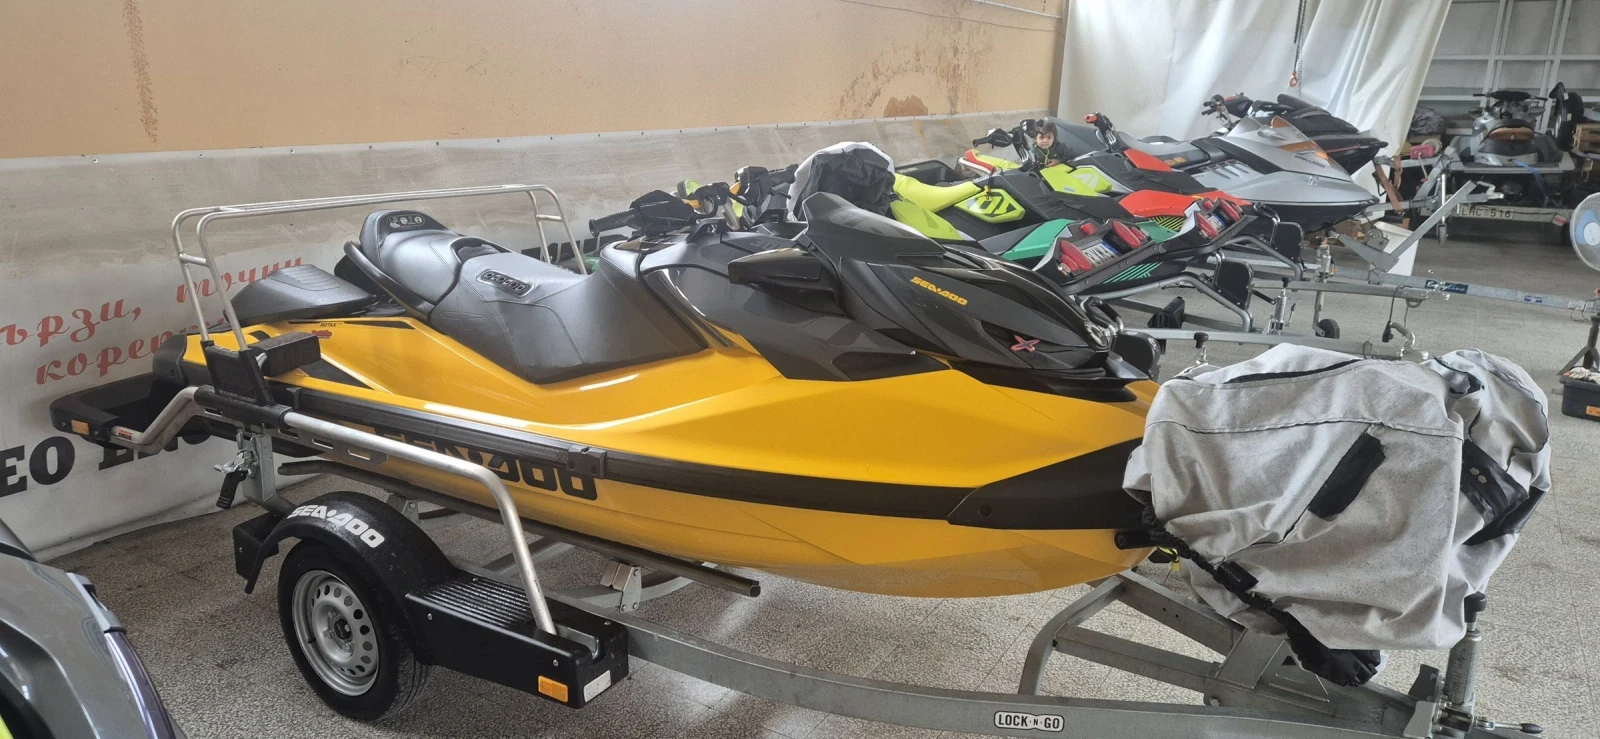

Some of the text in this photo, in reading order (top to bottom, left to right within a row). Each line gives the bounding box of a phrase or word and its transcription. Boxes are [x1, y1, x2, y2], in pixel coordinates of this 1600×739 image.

[0, 298, 142, 347] ързи,
[998, 714, 1028, 727] LOCK
[1044, 717, 1060, 729] GO
